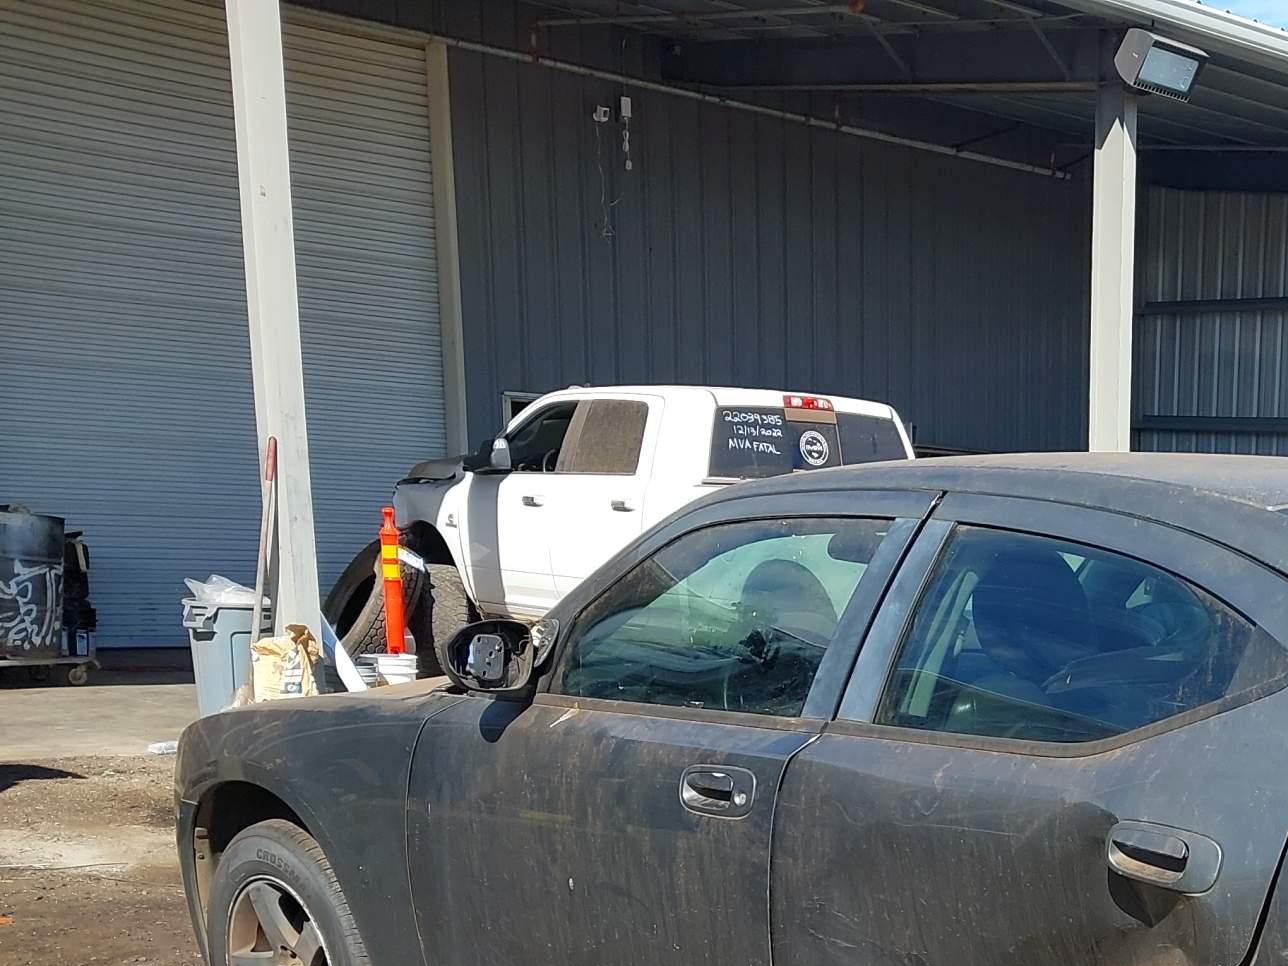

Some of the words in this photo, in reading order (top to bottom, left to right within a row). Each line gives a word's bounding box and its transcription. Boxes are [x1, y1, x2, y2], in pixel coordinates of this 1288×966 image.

[733, 424, 783, 437] 12/13/2022
[728, 437, 752, 450] MVA
[752, 441, 782, 454] FATAL
